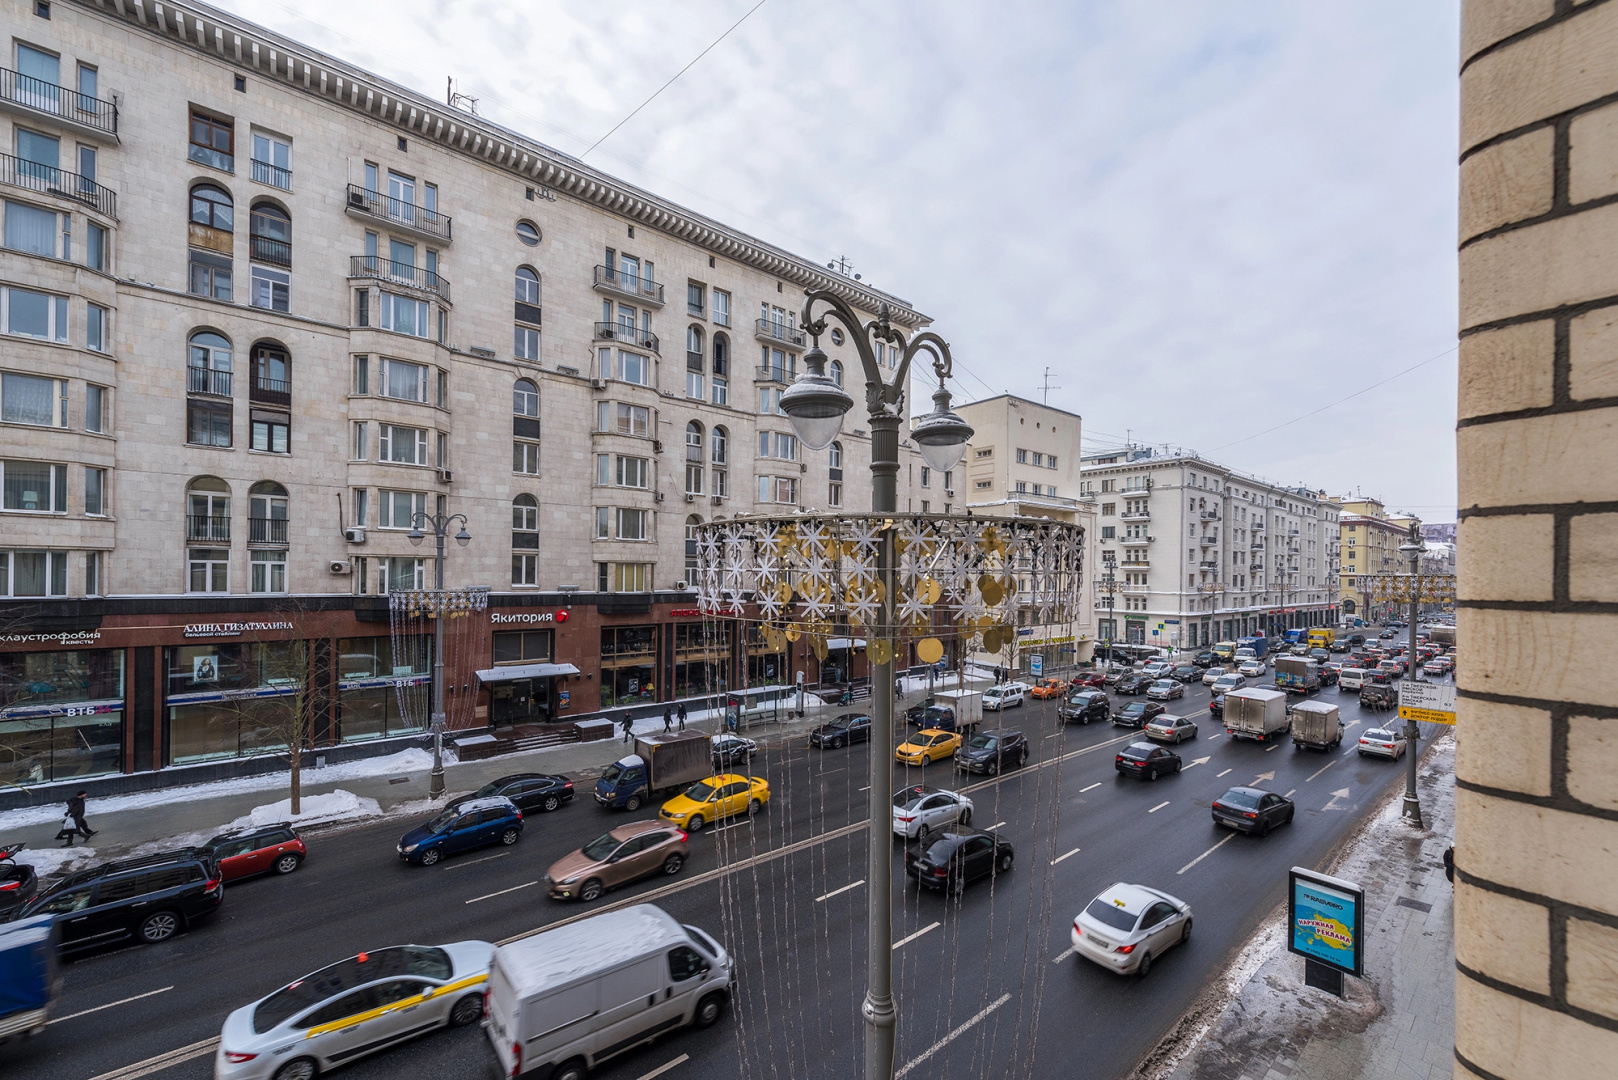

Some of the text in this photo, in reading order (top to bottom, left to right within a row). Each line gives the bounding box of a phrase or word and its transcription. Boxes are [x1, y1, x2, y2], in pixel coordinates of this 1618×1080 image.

[491, 613, 553, 624] Якитория
[183, 621, 293, 632] АЛИНА ГИЗАТУЛЛИНА
[67, 705, 112, 717] ВТБ24
[1298, 919, 1334, 930] НАРУЖНАЯ
[1316, 928, 1351, 944] РЕКЛАМА
